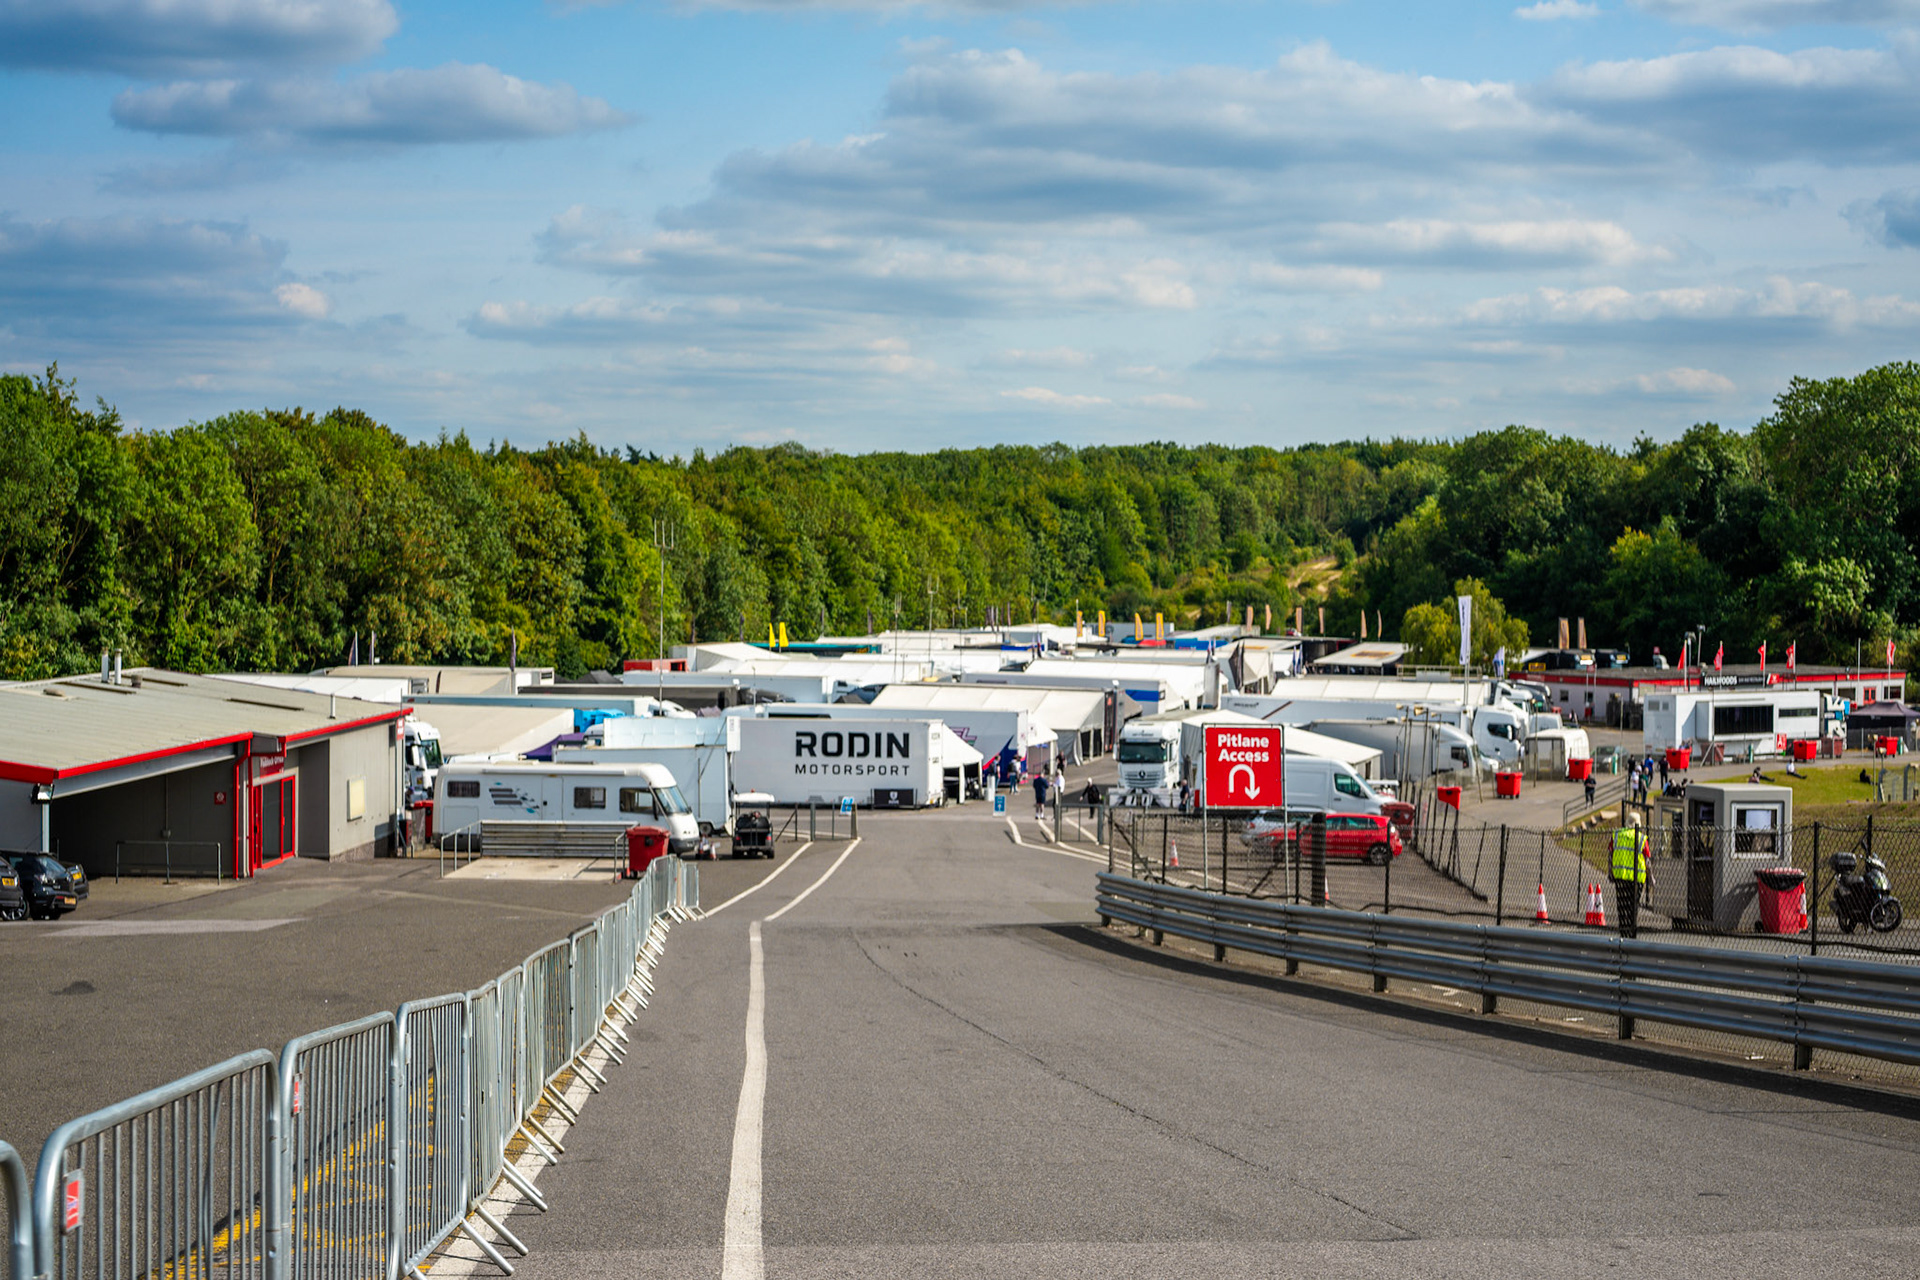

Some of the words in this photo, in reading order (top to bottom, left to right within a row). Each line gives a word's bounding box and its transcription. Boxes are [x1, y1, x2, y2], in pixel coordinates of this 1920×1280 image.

[795, 731, 910, 758] RODIN
[1217, 733, 1270, 748] Pitlane
[1217, 748, 1270, 763] Access
[795, 764, 910, 776] MOTORSPORT
